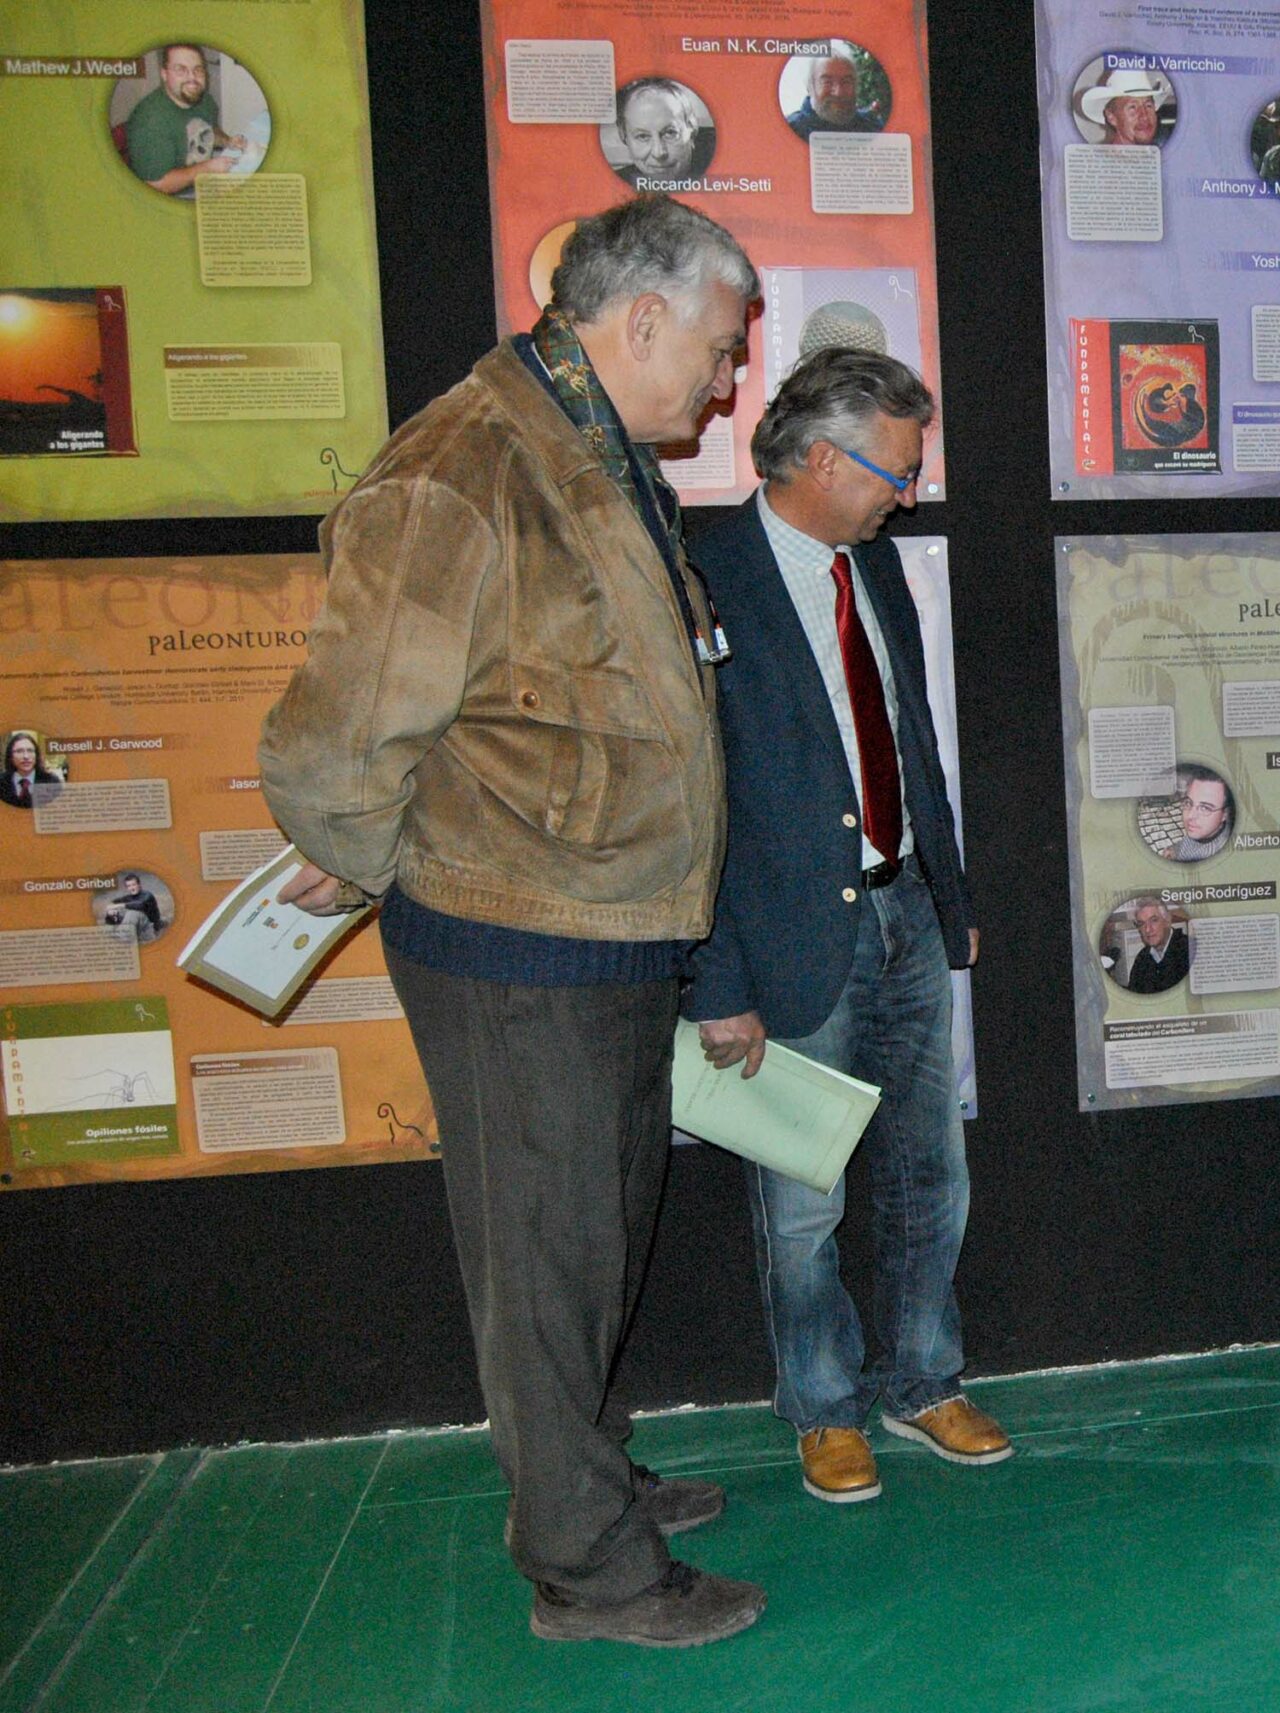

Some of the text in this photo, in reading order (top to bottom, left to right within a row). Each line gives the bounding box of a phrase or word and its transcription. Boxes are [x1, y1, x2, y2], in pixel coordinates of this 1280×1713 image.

[681, 37, 828, 54] Euan N. K. Clarkson
[6, 60, 69, 74] Mathew
[1107, 55, 1146, 69] David
[636, 177, 772, 192] Riccardo Levi-Setti
[1201, 180, 1256, 197] Anthony
[1259, 181, 1270, 194] J.
[1173, 452, 1217, 460] El dinosaurio
[48, 737, 163, 753] Russell J. Garwood
[1234, 834, 1280, 848] Alberto
[24, 880, 73, 892] Gonzalo
[1161, 884, 1272, 903] Sergio Rodríguez
[86, 1123, 168, 1138] Opiliones fósiles
